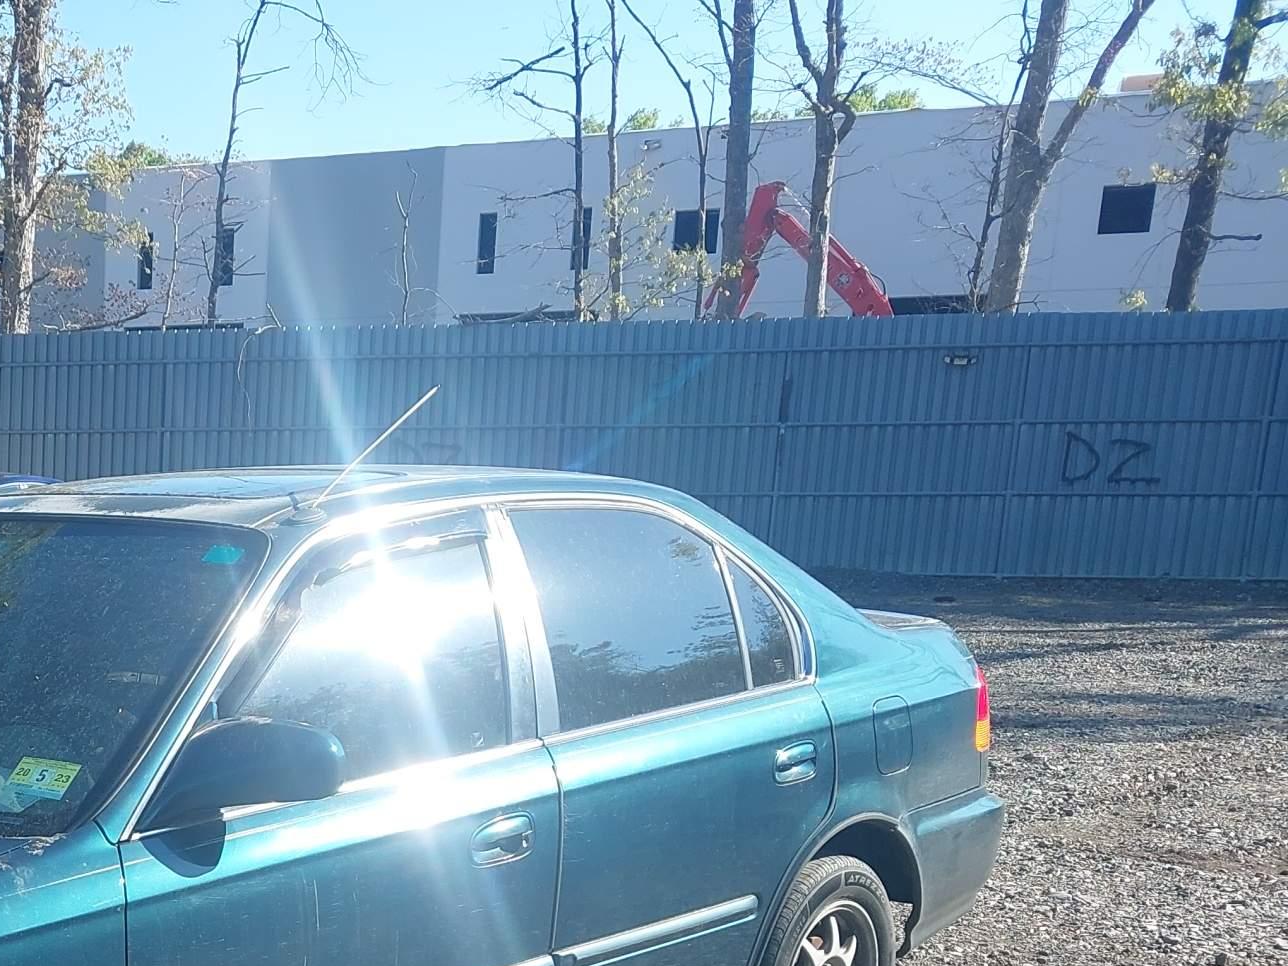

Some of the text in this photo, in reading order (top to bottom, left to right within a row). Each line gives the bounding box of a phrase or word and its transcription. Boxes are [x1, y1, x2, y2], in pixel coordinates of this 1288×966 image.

[16, 767, 71, 784] 20 5 23
